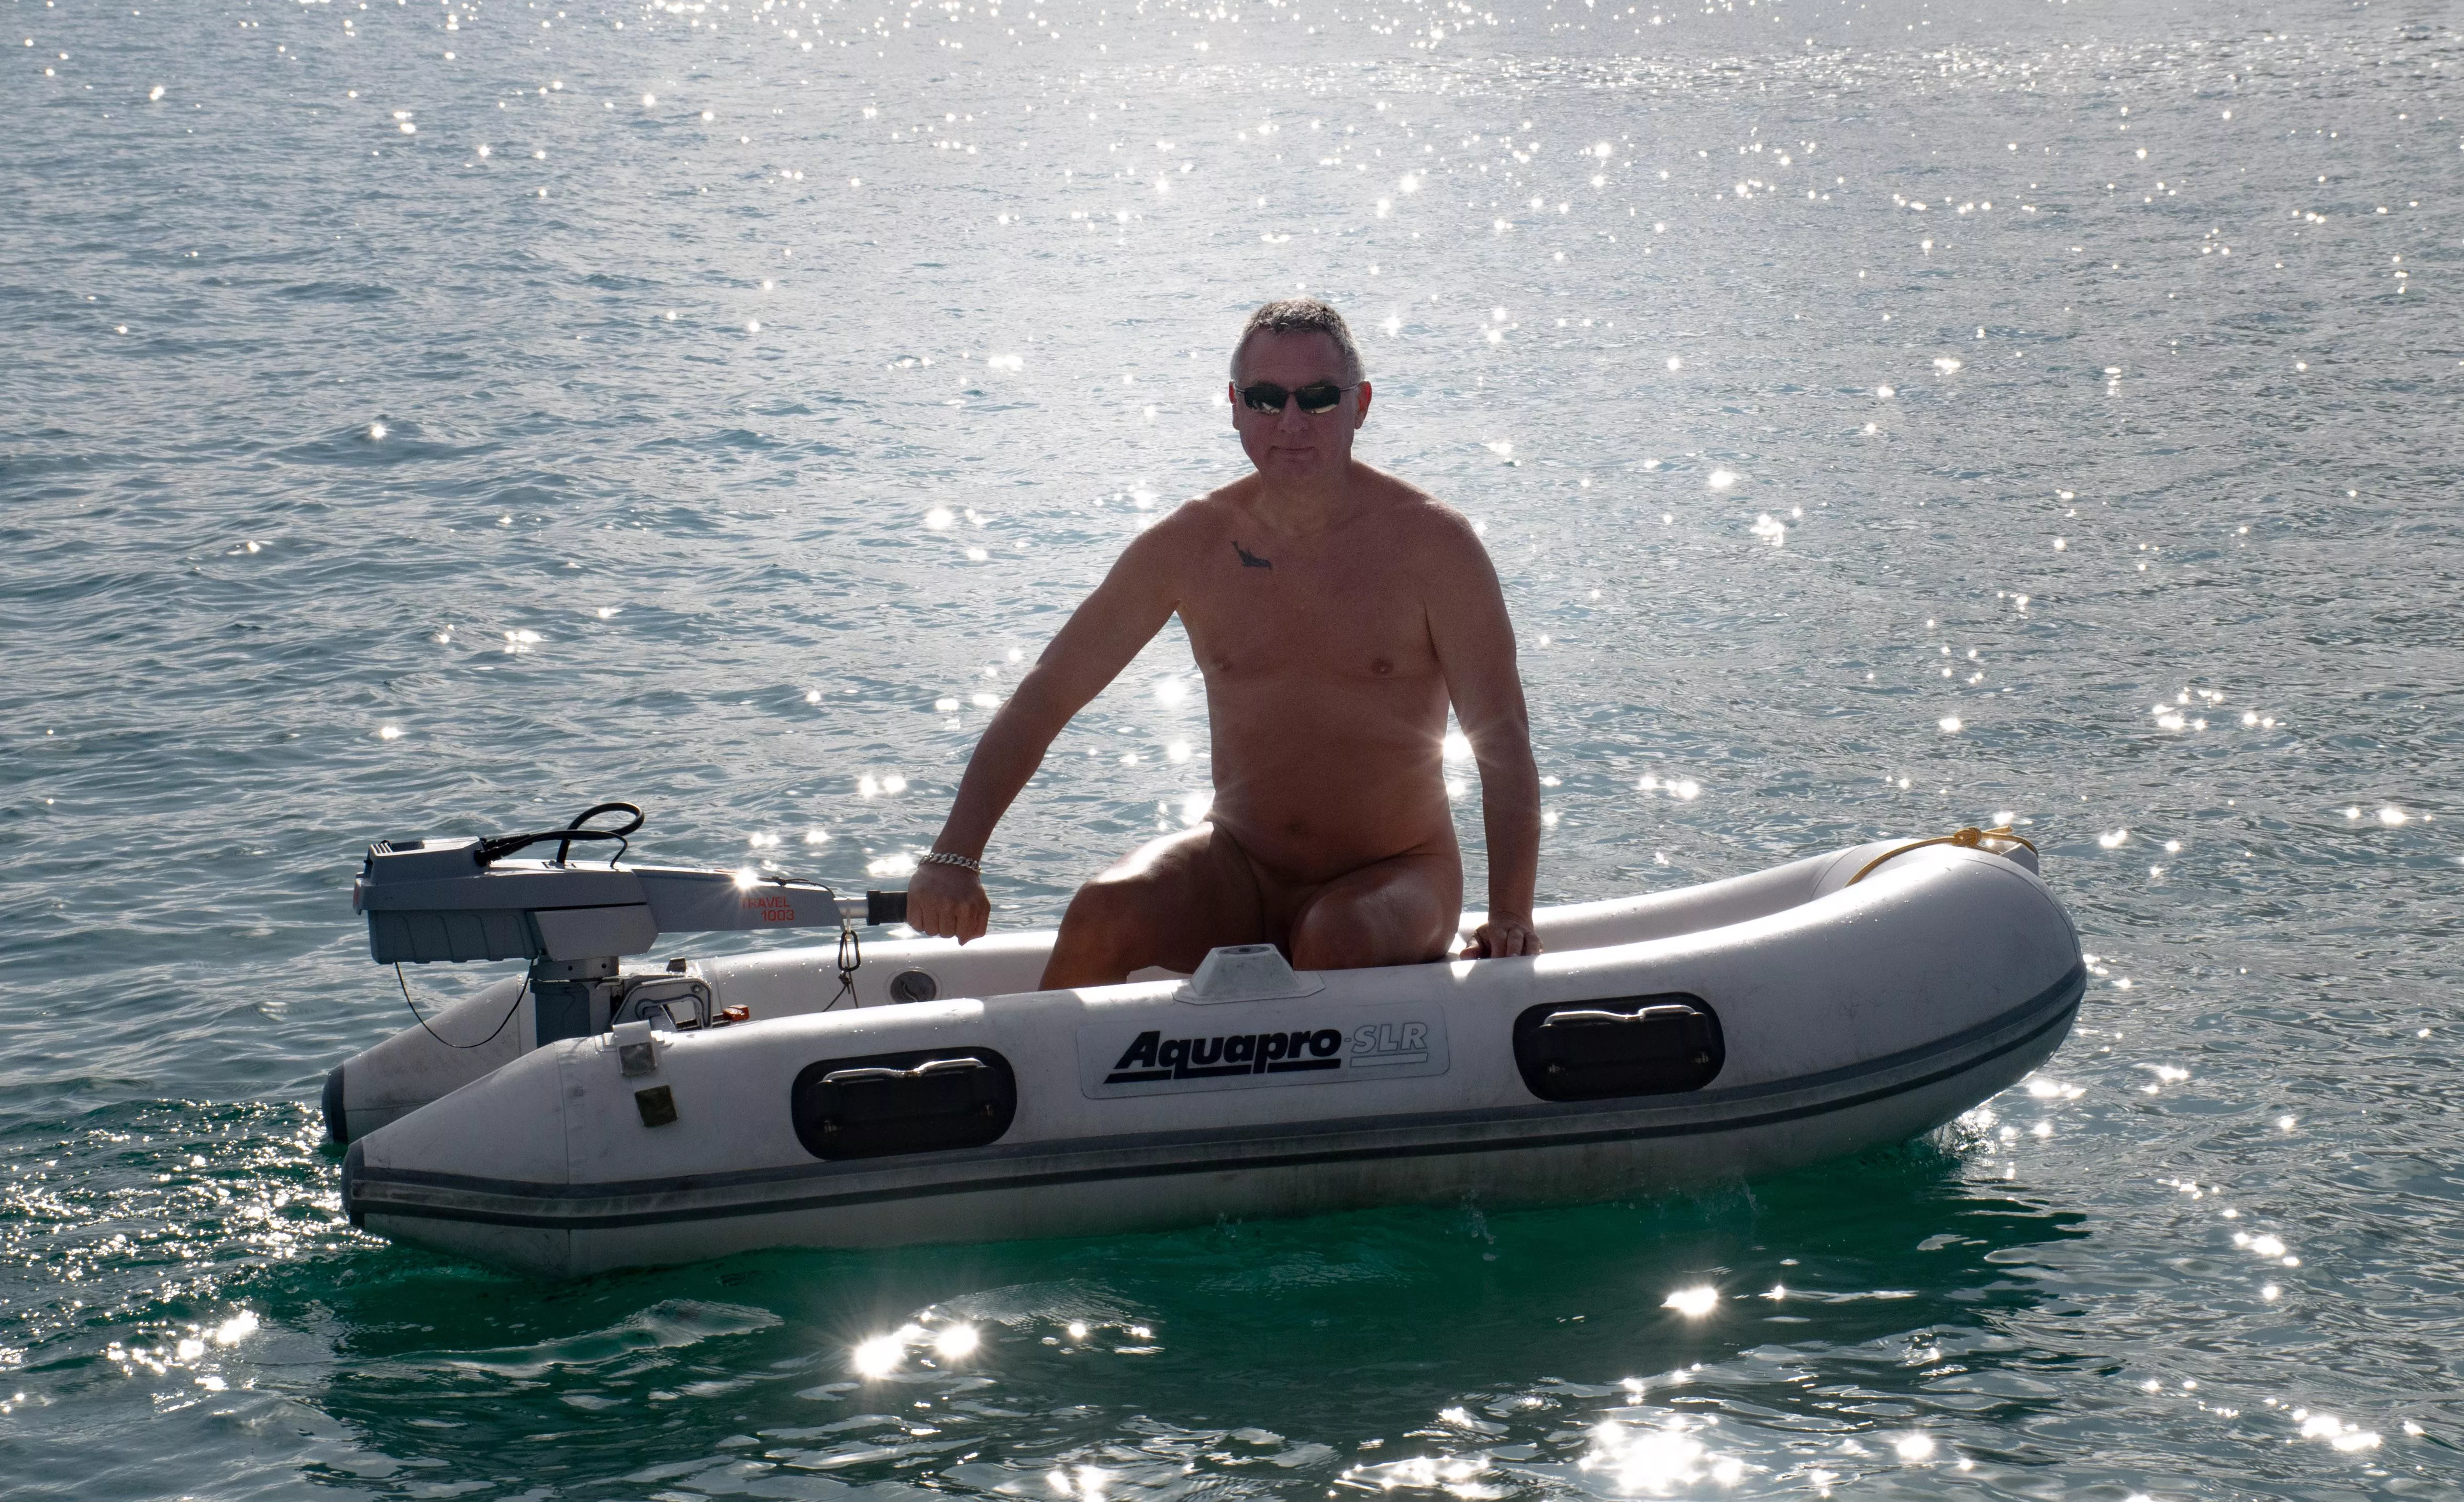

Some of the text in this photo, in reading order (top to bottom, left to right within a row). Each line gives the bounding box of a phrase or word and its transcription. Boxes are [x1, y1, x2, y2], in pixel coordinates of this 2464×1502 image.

[739, 896, 790, 909] TRAVEL
[761, 909, 795, 922] 1003
[1113, 1028, 1342, 1079] Aquapro
